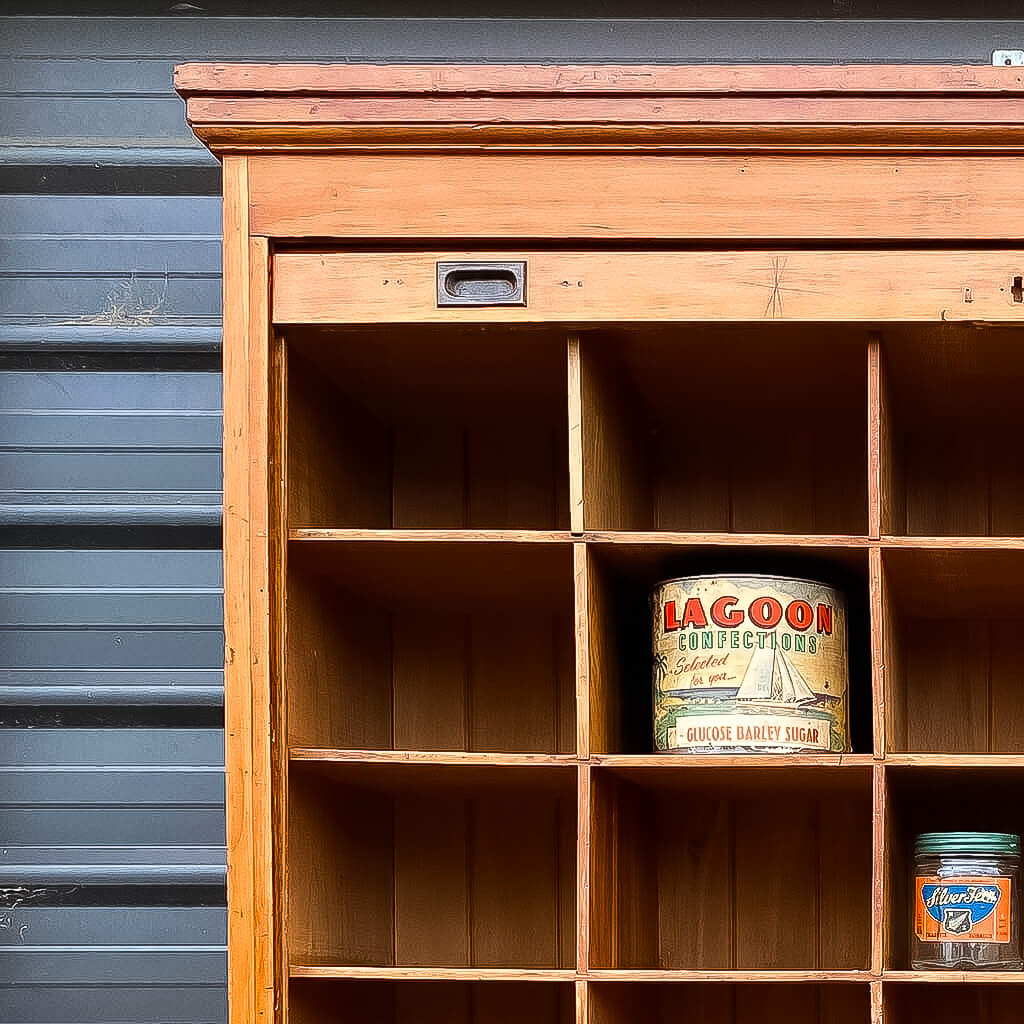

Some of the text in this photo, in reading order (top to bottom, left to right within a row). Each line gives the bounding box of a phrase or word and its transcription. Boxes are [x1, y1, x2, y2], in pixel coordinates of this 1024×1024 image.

[664, 595, 833, 636] LAGOON
[678, 631, 817, 655] CONFECTIONS
[673, 652, 730, 676] Selected
[687, 726, 819, 744] GLUCOSE BARLEY SUGAR
